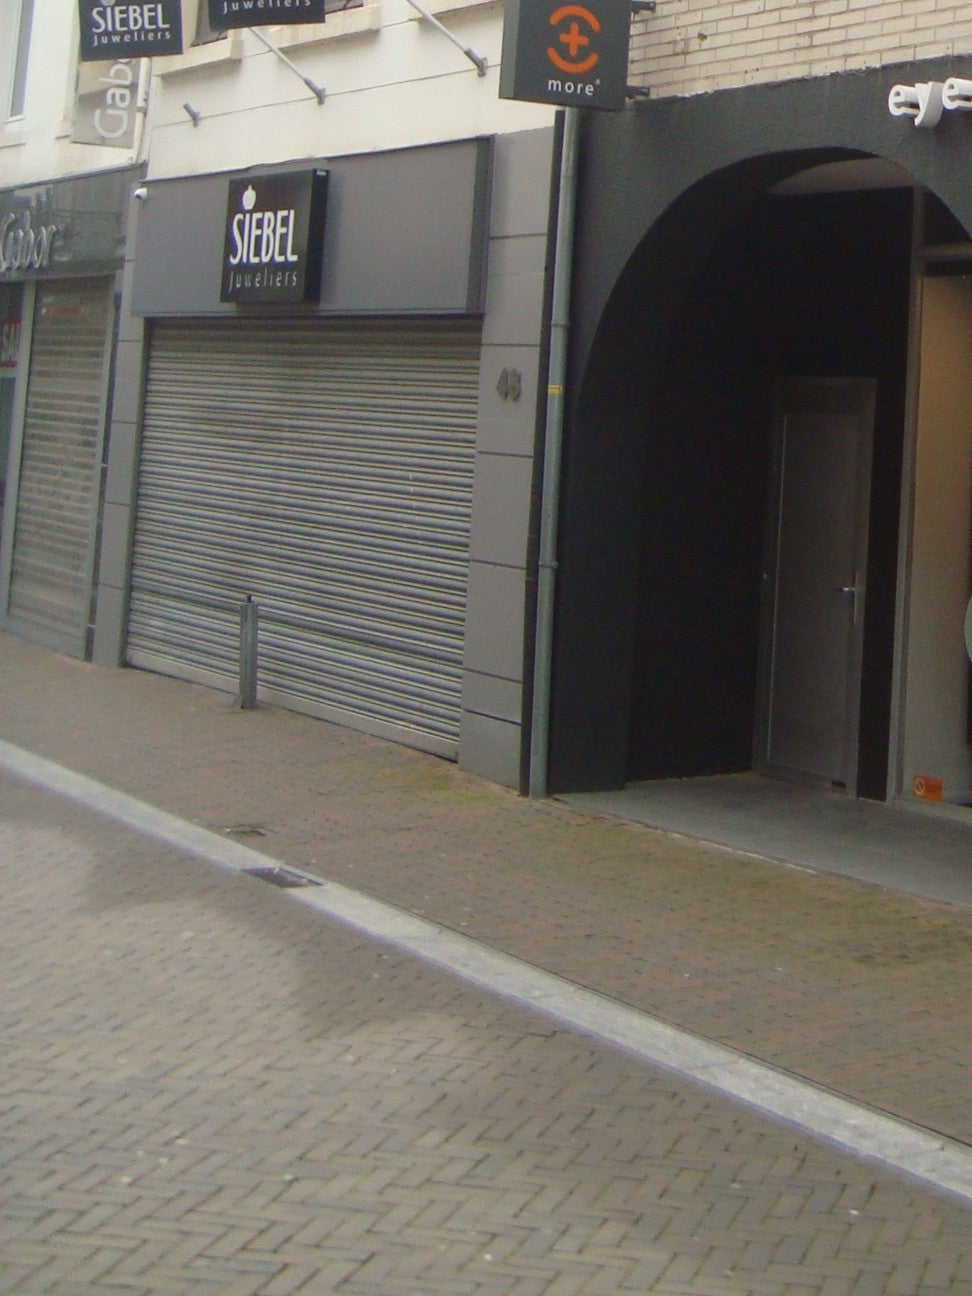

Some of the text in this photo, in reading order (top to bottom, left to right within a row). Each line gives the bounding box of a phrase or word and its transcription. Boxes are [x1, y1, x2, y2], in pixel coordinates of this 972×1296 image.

[91, 3, 170, 33] SIEBEL
[93, 57, 133, 140] Gab
[547, 79, 595, 96] more
[229, 209, 299, 265] SIEBEL
